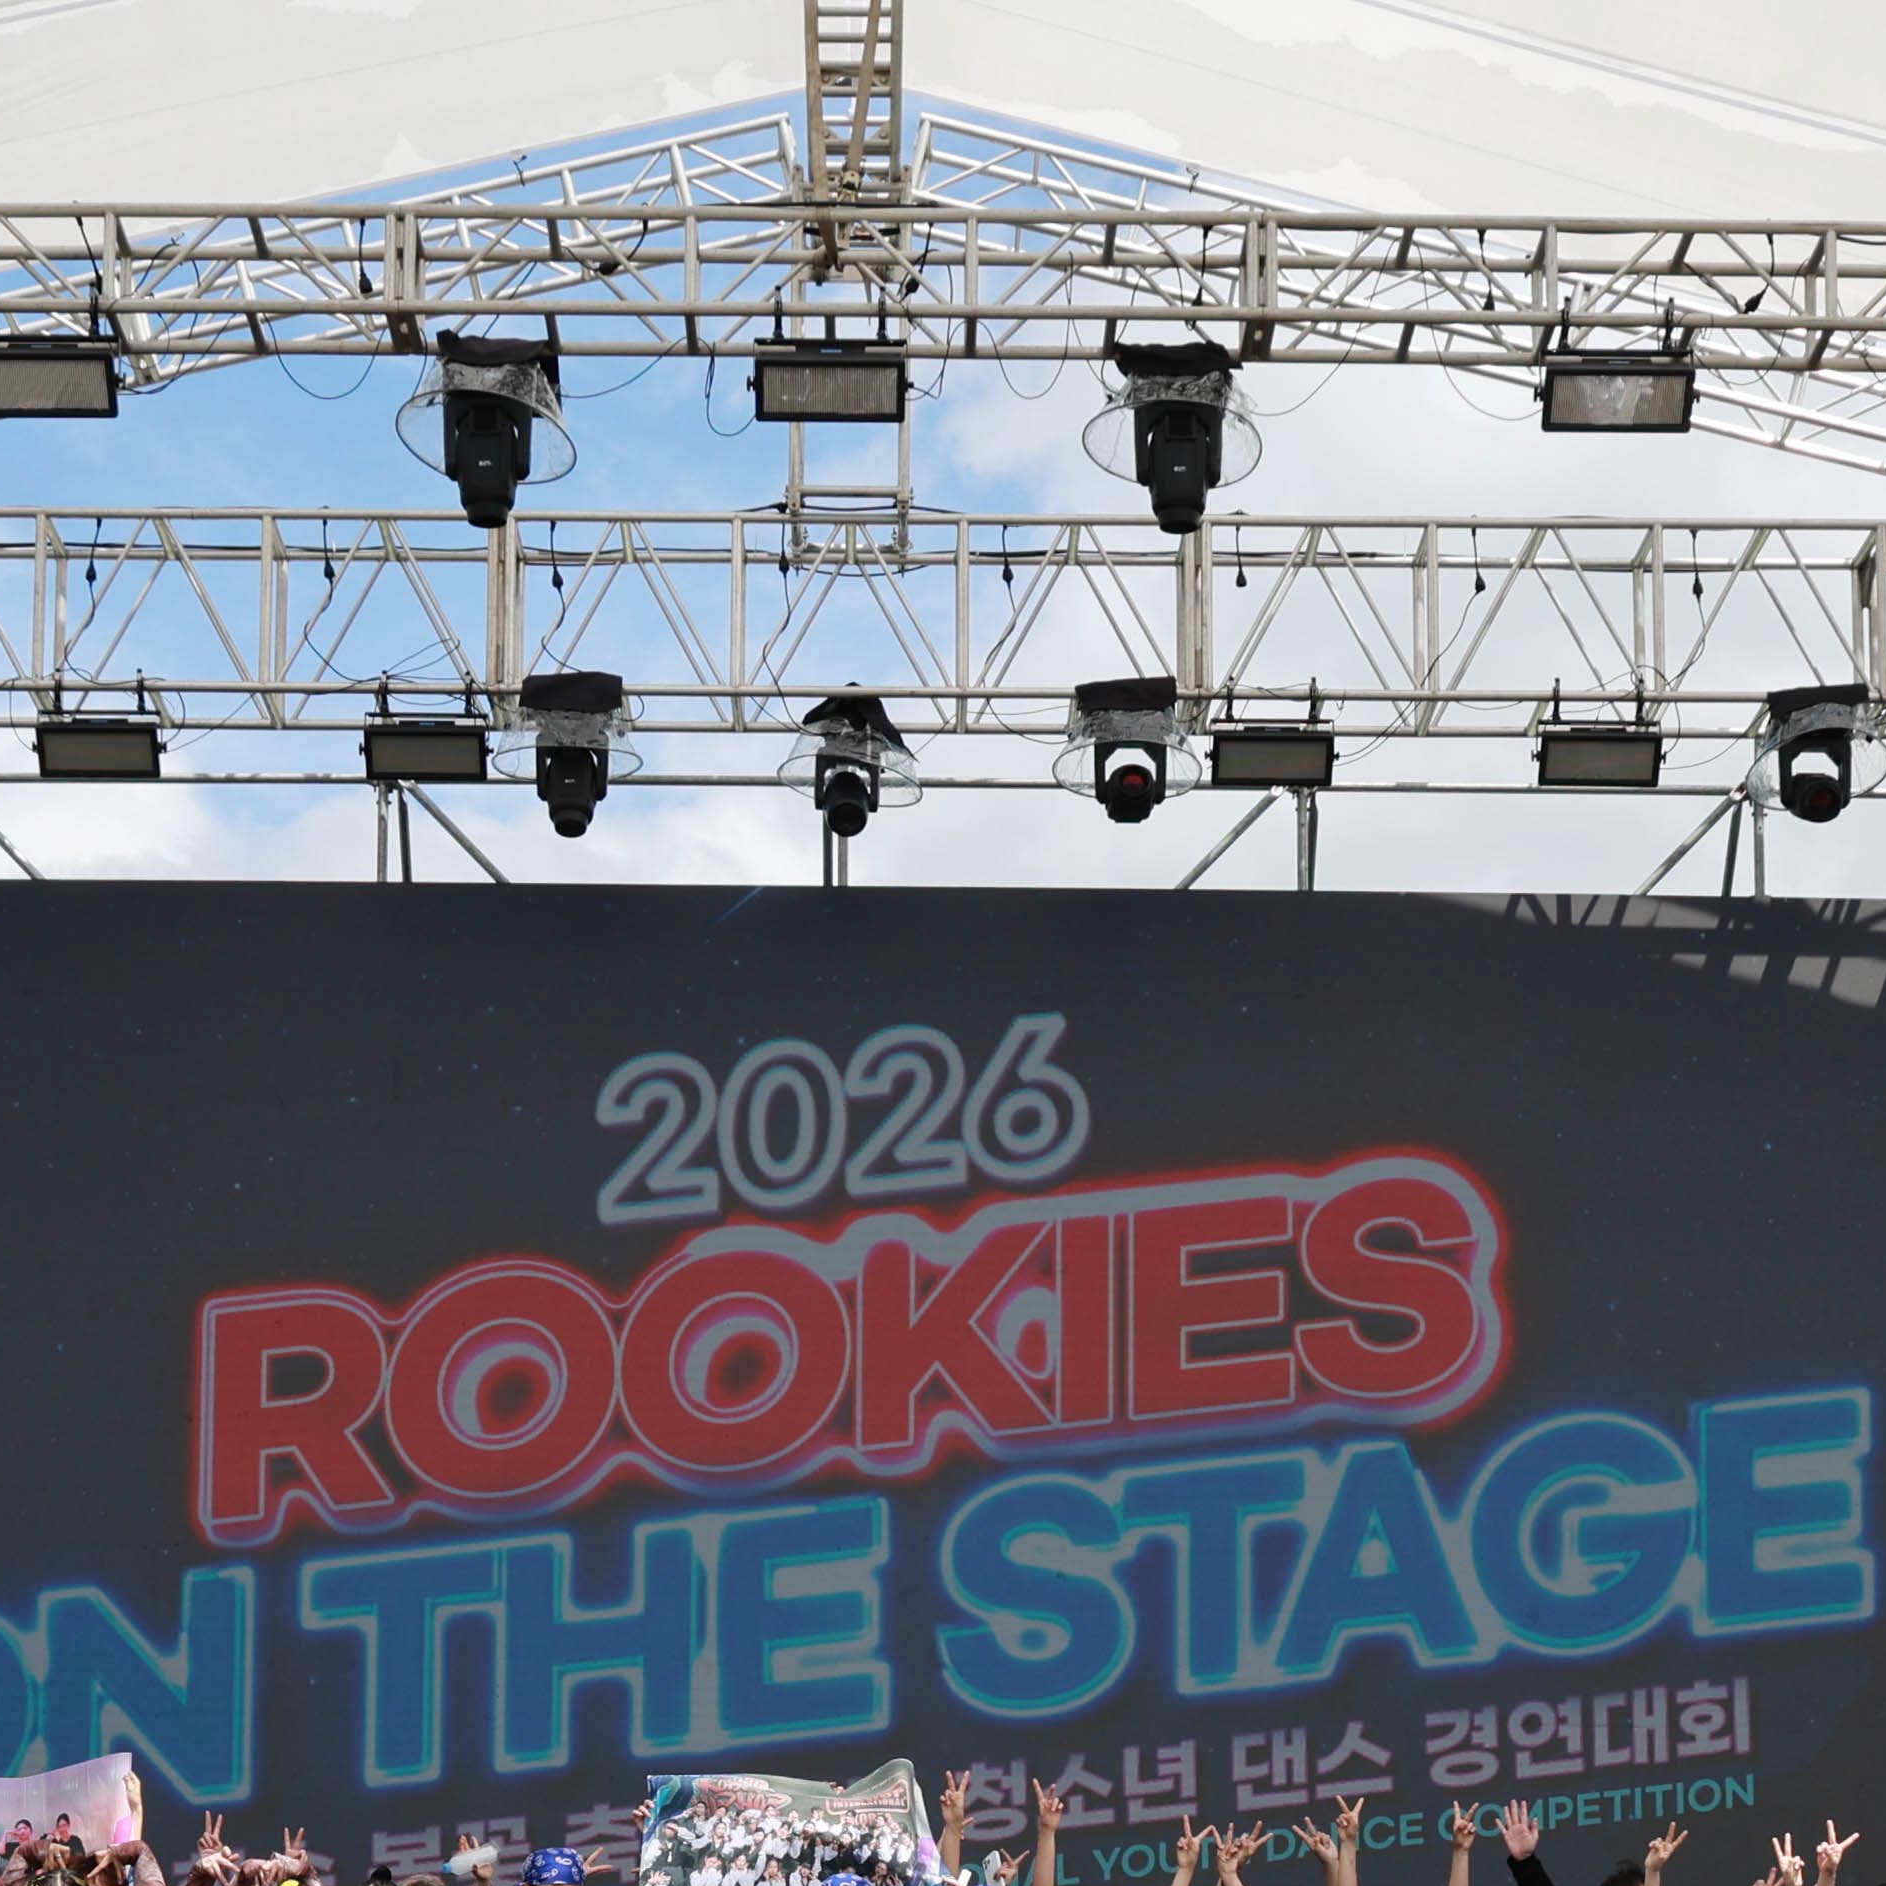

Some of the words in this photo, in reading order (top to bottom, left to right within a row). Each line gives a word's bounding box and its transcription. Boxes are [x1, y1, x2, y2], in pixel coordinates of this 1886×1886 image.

[595, 1013, 1089, 1225] 2026
[198, 1150, 1503, 1545] ROOKIES
[302, 1492, 891, 1785] THE
[938, 1388, 1876, 1720] STAGE
[958, 1740, 1198, 1842] 청소년
[1231, 1720, 1393, 1812] 댄스
[1425, 1676, 1752, 1788] 경연대회
[1093, 1833, 1251, 1880] YOUT
